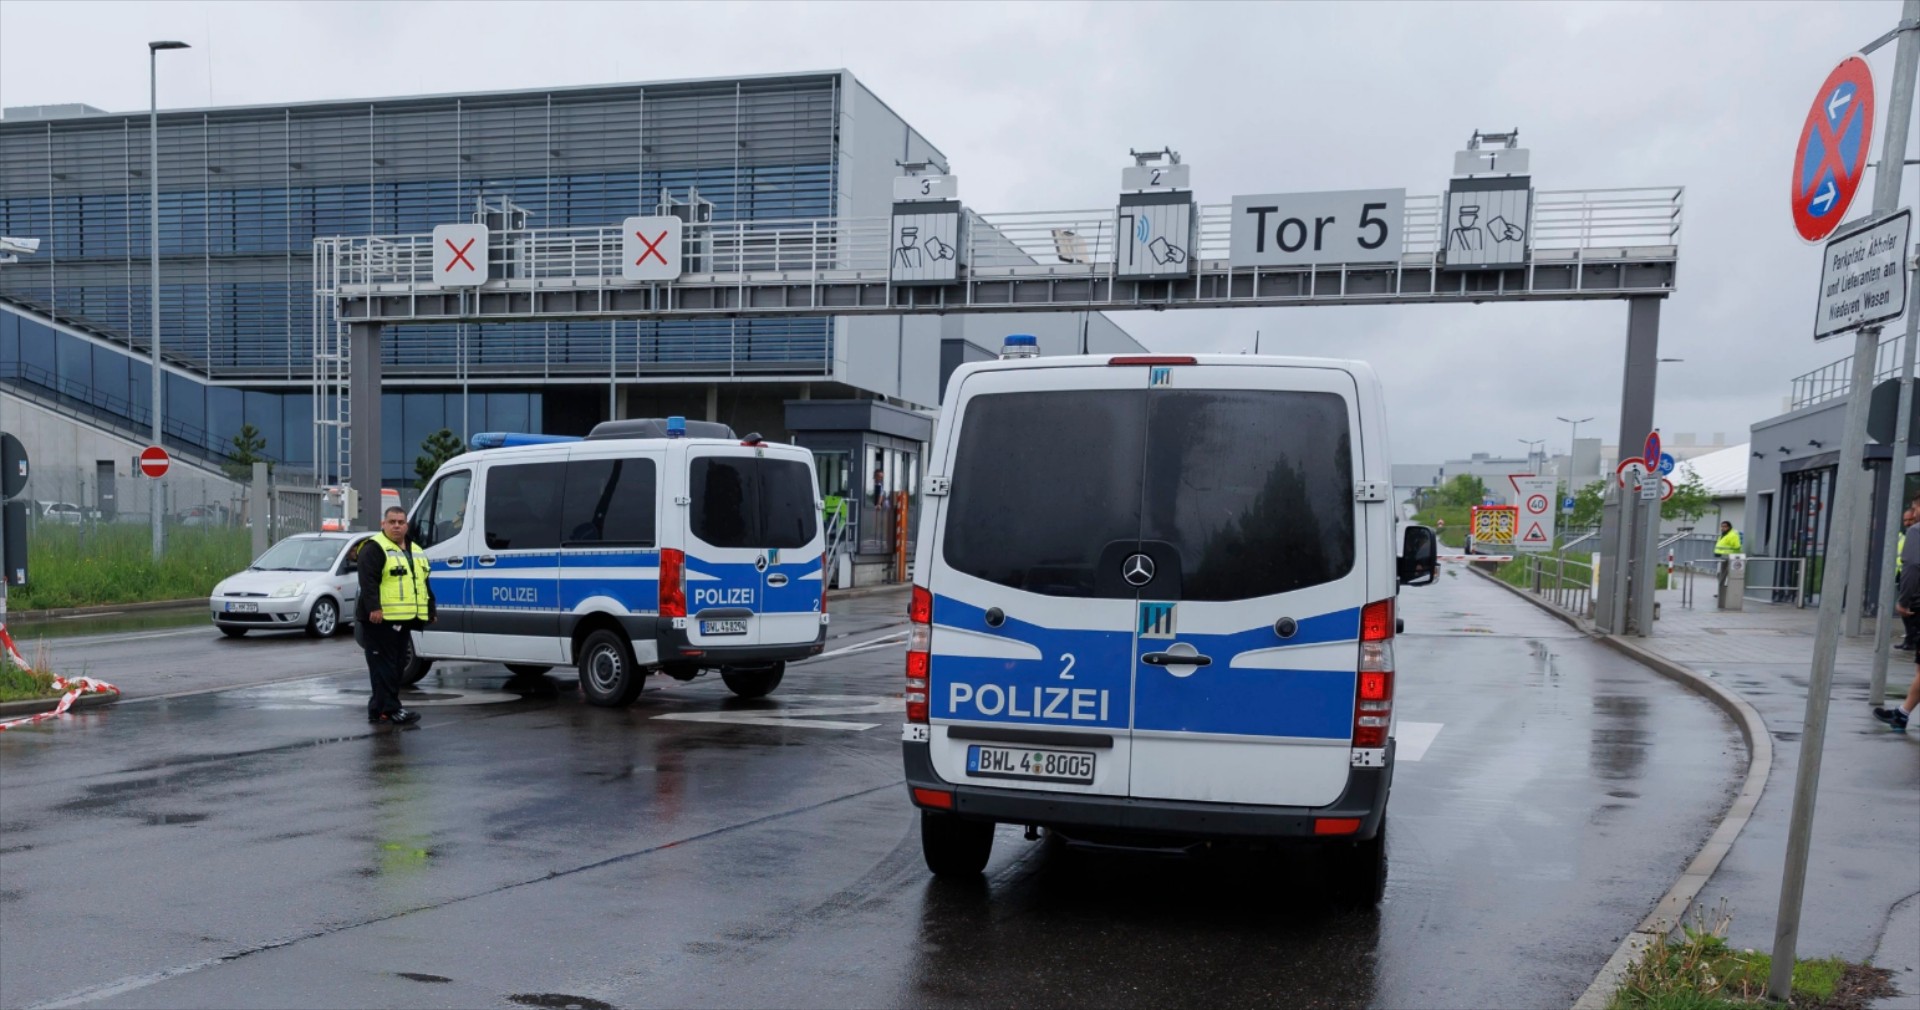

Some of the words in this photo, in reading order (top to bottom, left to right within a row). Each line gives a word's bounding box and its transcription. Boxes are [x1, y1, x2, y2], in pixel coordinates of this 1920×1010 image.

[1489, 152, 1496, 171] 1
[920, 178, 931, 195] 3
[1150, 168, 1161, 186] 2
[1246, 206, 1336, 253] Tor
[1356, 202, 1389, 250] 5
[1832, 246, 1866, 271] Parkplatz
[1826, 278, 1840, 298] und
[1841, 266, 1881, 292] Lieferanten
[1883, 261, 1896, 277] am
[1828, 299, 1860, 321] Niederen
[1863, 289, 1890, 310] Wasen
[1531, 499, 1544, 509] 40
[492, 586, 538, 602] POLIZEI
[694, 588, 754, 605] POLIZEI
[813, 599, 820, 612] 2
[1059, 652, 1075, 680] 2
[949, 682, 1109, 721] POLIZEI
[981, 750, 1015, 771] BWL
[1019, 753, 1031, 772] 4
[1045, 754, 1091, 776] 8005
